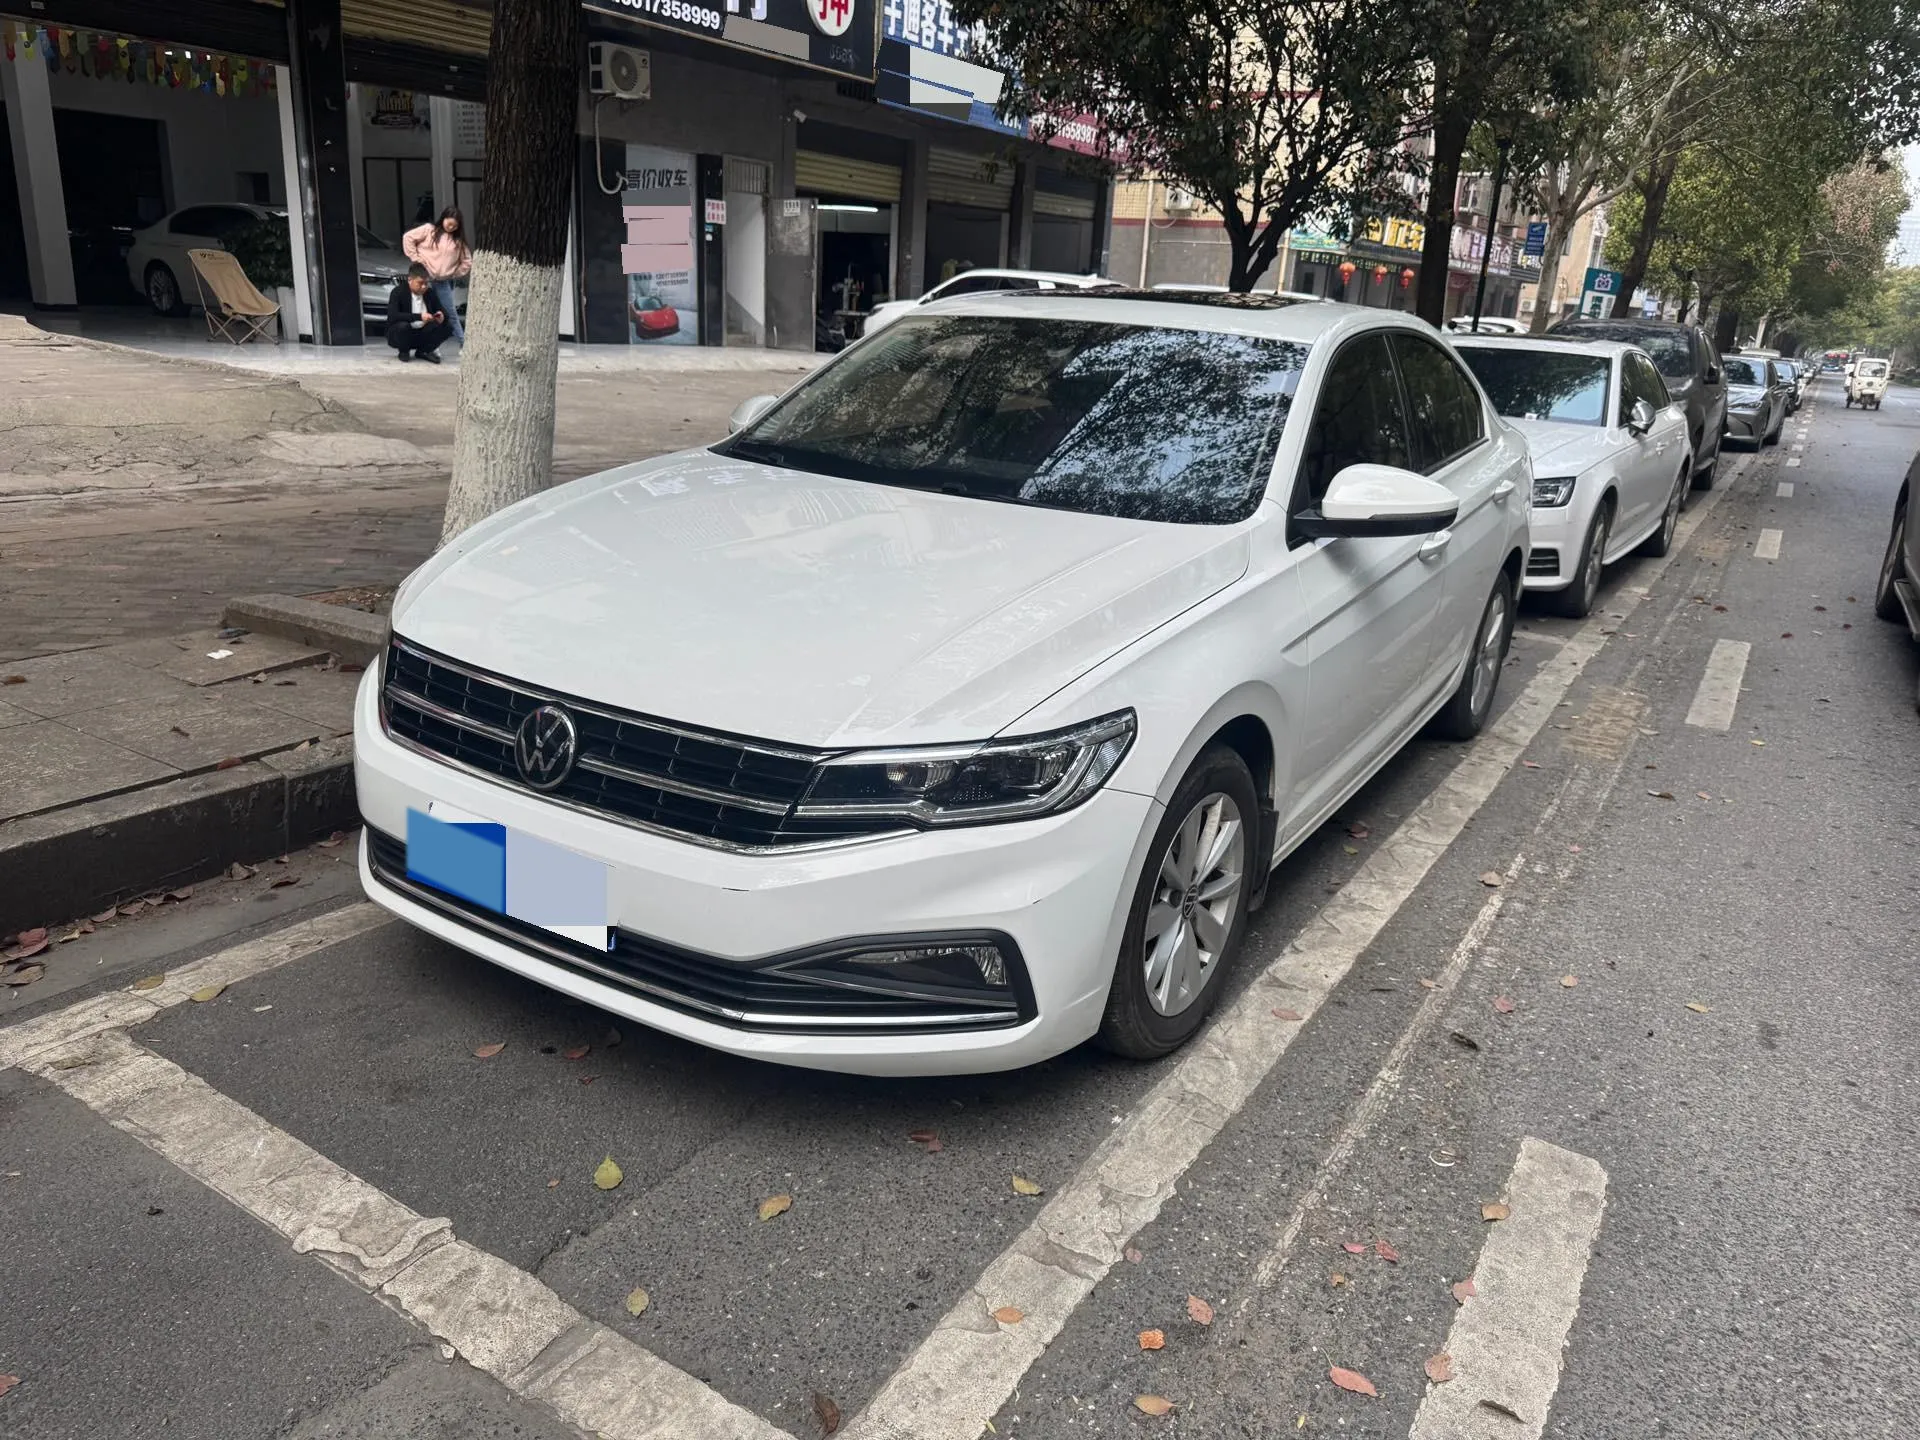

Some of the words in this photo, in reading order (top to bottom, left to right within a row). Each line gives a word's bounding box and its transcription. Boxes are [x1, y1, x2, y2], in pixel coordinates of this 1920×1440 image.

[612, 0, 721, 30] 017358999
[627, 168, 688, 190] 高价收车
